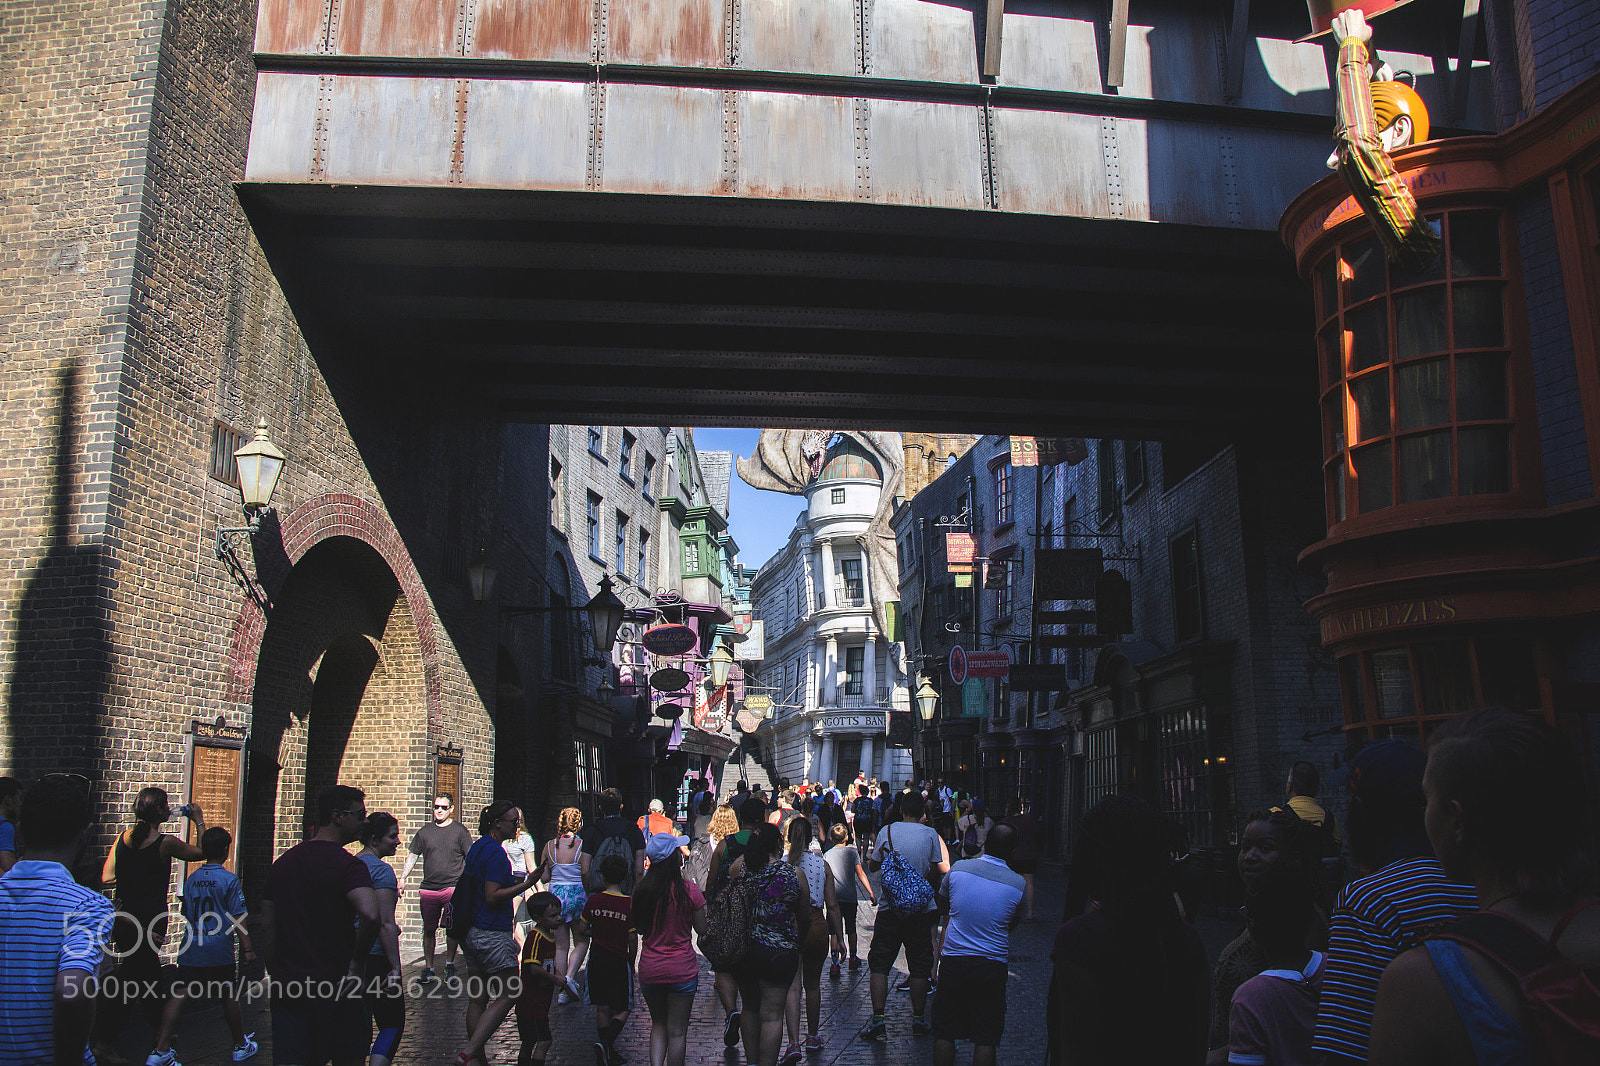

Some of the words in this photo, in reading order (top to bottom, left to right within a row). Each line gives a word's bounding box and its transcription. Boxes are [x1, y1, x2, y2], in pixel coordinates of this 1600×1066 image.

[1402, 170, 1447, 190] HEM
[1011, 440, 1057, 453] BOOK
[1336, 597, 1457, 634] WHEEZES
[813, 717, 860, 727] NGOTTS
